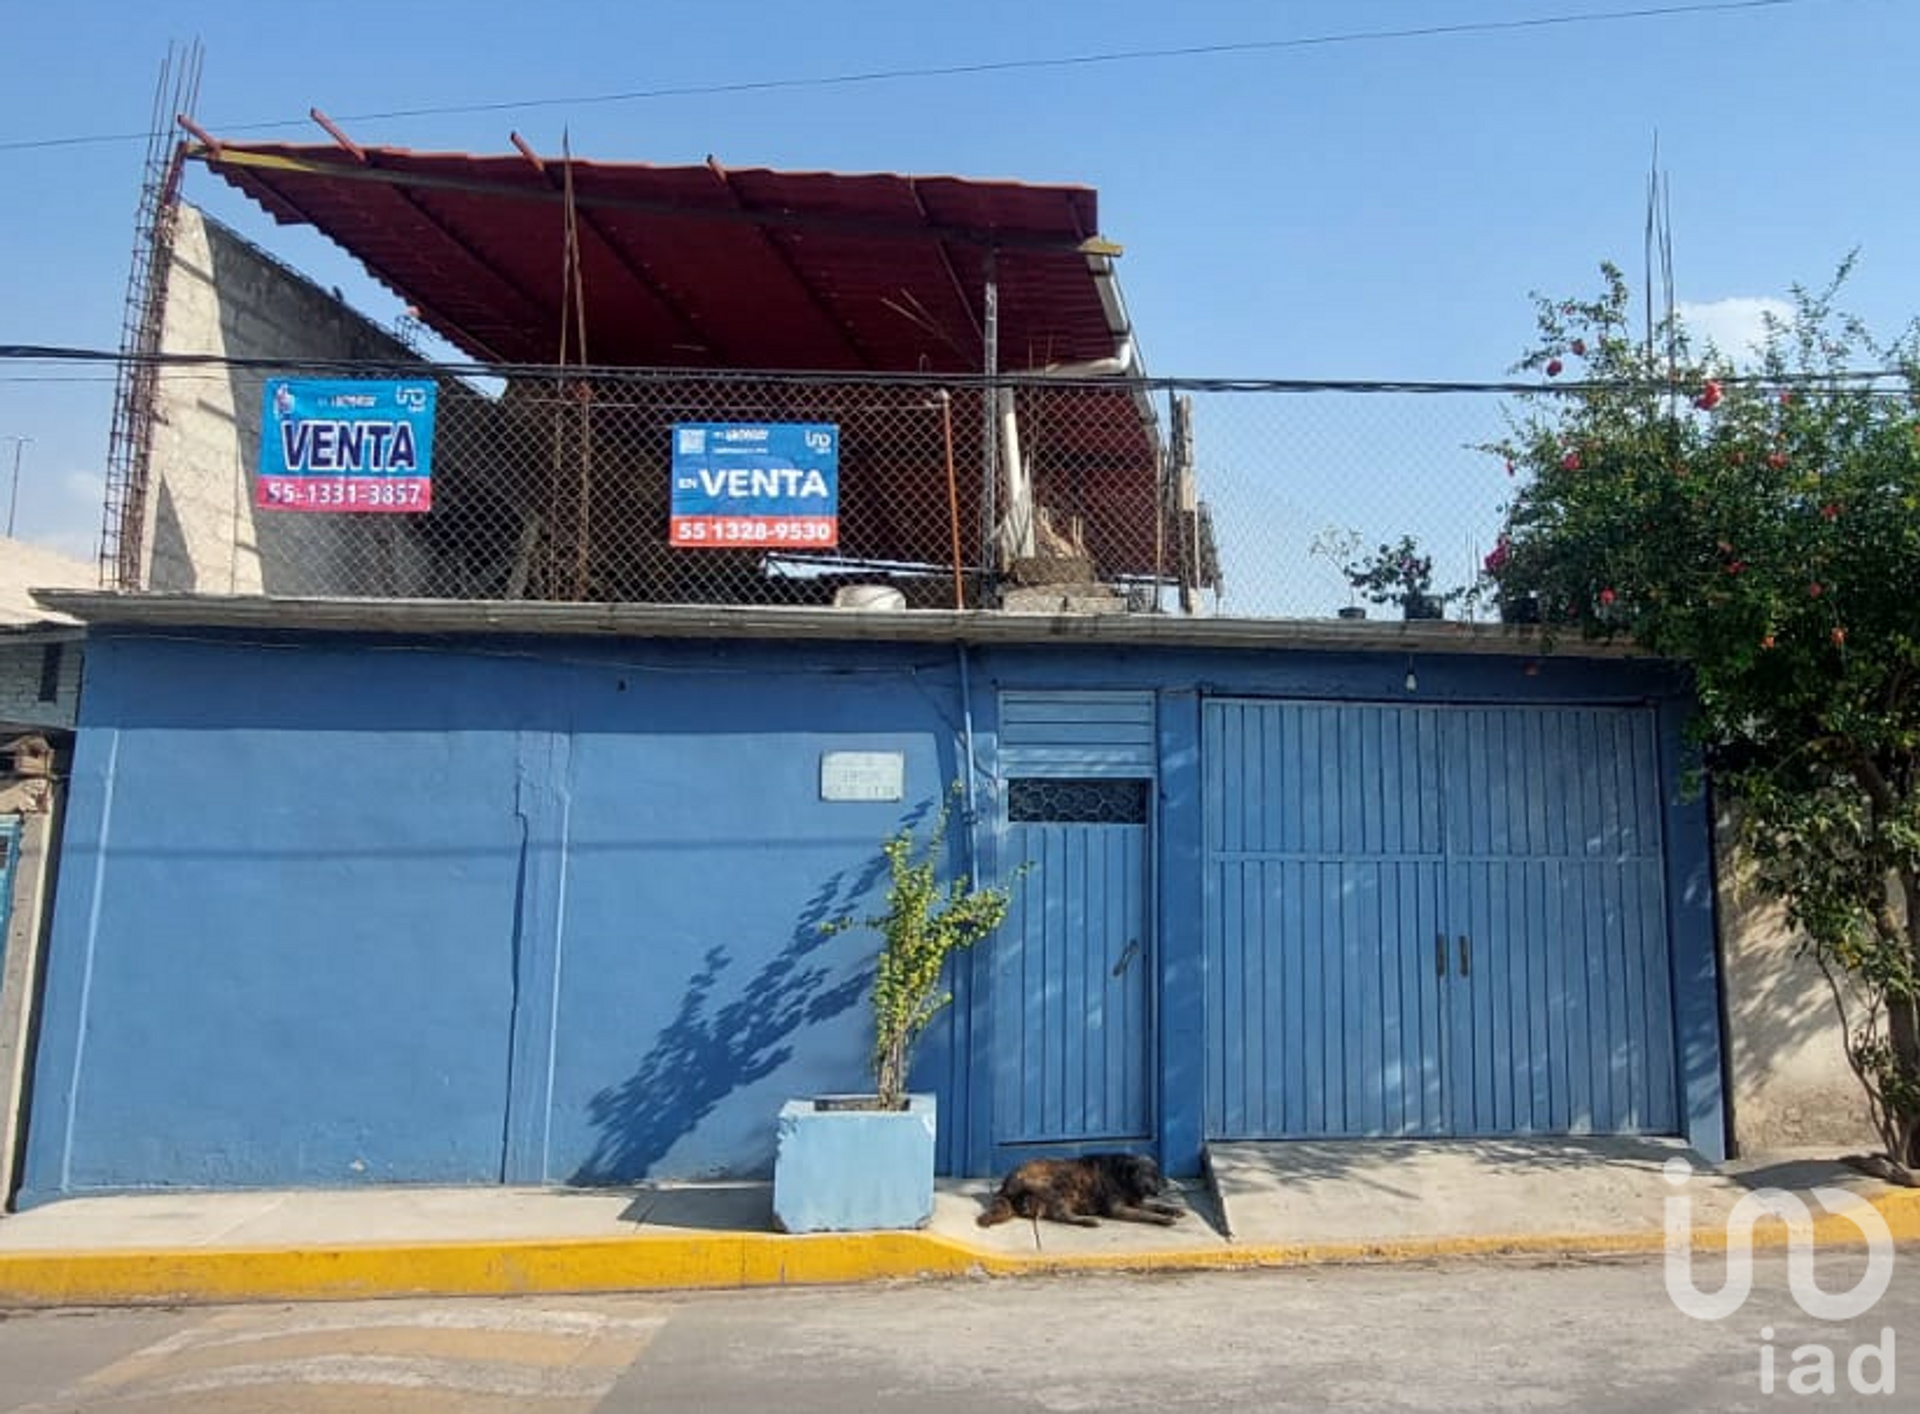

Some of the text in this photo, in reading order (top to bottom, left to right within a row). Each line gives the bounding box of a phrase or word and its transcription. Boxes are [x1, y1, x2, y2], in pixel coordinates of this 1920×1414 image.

[281, 420, 416, 471] VENTA
[678, 469, 828, 497] EN VENTA
[678, 522, 830, 541] 55 1328-9530
